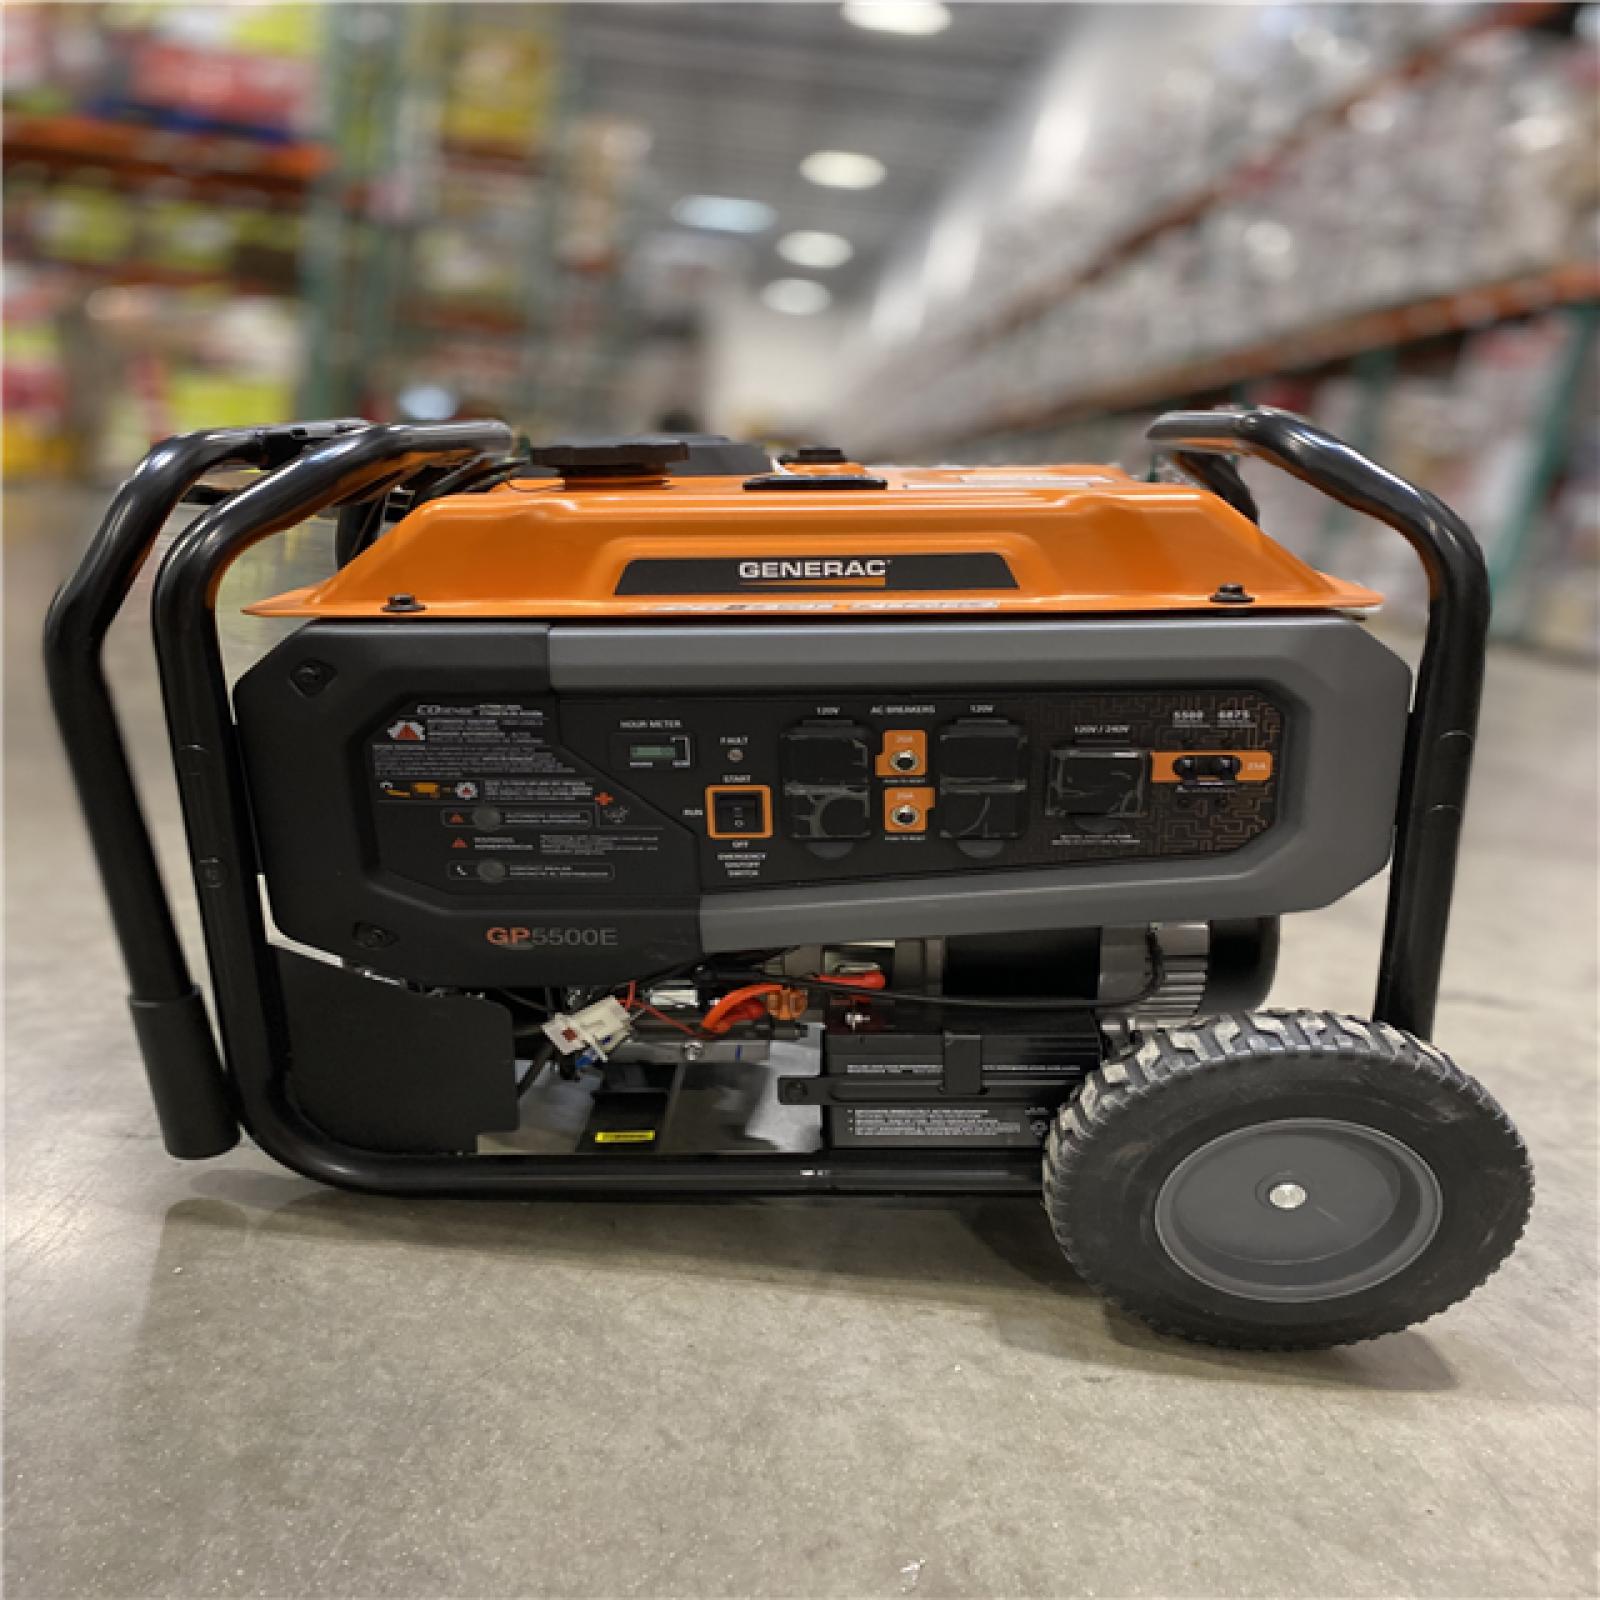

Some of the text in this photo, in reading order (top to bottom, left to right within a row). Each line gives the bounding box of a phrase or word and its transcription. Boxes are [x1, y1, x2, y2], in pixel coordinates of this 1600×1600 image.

[739, 559, 887, 579] GENERAC
[1172, 709, 1204, 720] 5500
[649, 719, 681, 728] METER
[719, 736, 748, 745] FAULT
[485, 926, 619, 946] GP5500E
